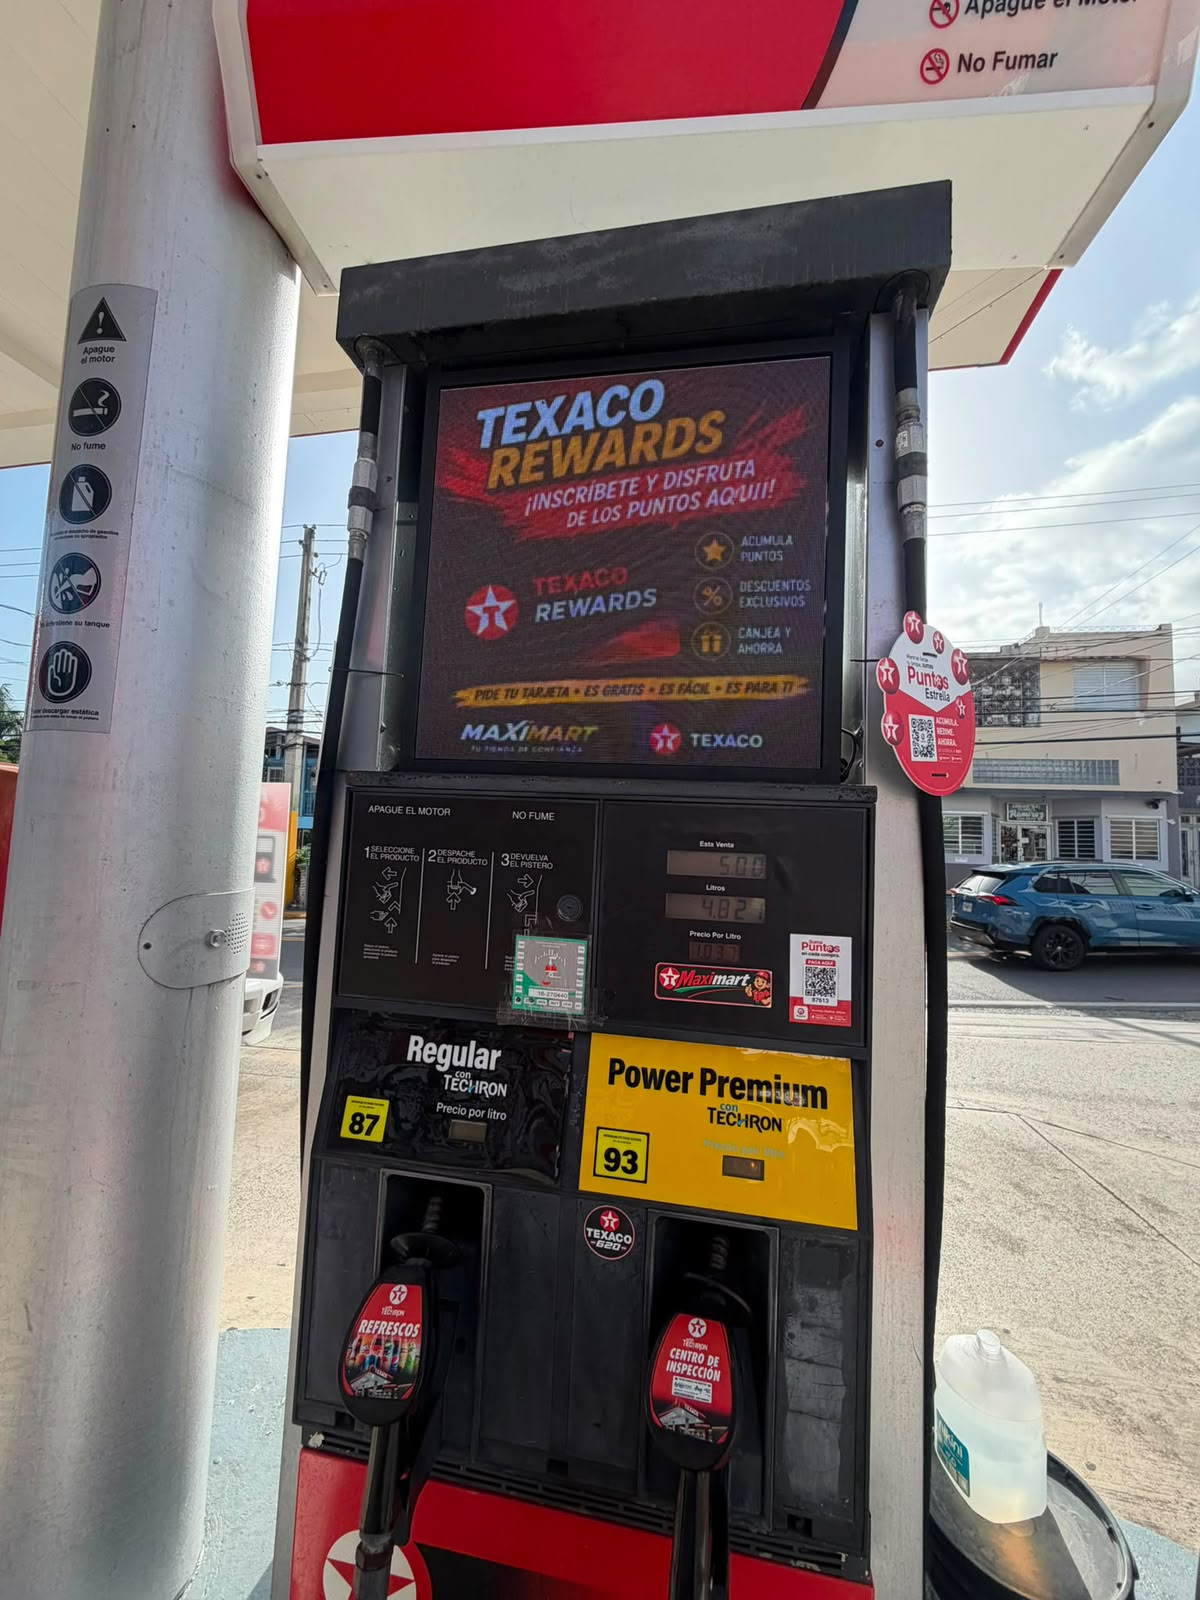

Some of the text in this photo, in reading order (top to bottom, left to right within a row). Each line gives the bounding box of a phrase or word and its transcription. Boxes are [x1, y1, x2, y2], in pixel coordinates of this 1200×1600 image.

[964, 0, 1044, 20] Apague
[957, 50, 1059, 73] No Fumar
[82, 345, 116, 356] Apague
[80, 355, 116, 365] el motor
[476, 379, 666, 450] TEXACO
[71, 441, 107, 452] No fume
[486, 410, 726, 490] REWARDS
[646, 473, 658, 492] Y
[663, 458, 757, 491] DISFRUTA
[567, 510, 587, 529] DE
[591, 506, 621, 526] LOS
[627, 491, 701, 519] PUNTOS
[740, 535, 794, 547] ACUMULA
[740, 550, 784, 563] PUNTOS
[532, 566, 629, 597] TEXACO
[739, 578, 812, 593] DESCUENTOS
[534, 588, 658, 624] REWARDS
[739, 594, 806, 609] EXCLUSIVOS
[84, 620, 111, 629] tanque
[738, 626, 792, 640] CANJEA Y
[738, 642, 784, 655] AHORRA
[907, 665, 950, 691] Puntos
[474, 680, 795, 701] PIDE TU TARJETA ES GRATIS ES FÁCIL ES PARA TI
[925, 687, 951, 702] Estrella
[690, 732, 763, 749] TEXACO
[368, 805, 451, 817] APAGUE EL MOTOR
[512, 811, 555, 821] NO FUME
[364, 846, 416, 858] 1 SELECCIONE
[699, 841, 735, 849] Esta Venta
[380, 854, 420, 862] PRODUCTO
[427, 849, 476, 863] 2 DESPACHE
[447, 857, 488, 866] PRODUCTO
[500, 853, 549, 867] 3 DEVUELVA
[520, 861, 554, 870] PISTERO
[706, 884, 726, 893] Litros
[689, 930, 742, 941] Precio Por Litro
[801, 941, 841, 954] Puntos
[675, 969, 751, 989] Maximart
[407, 1034, 502, 1072] Regular
[455, 1071, 472, 1079] con
[444, 1074, 508, 1098] TECHRON
[607, 1057, 829, 1110] Power Premium
[436, 1102, 507, 1121] Precio por litro
[719, 1102, 739, 1113] con
[349, 1112, 381, 1136] 87
[707, 1107, 783, 1134] TECHRON
[603, 1147, 639, 1175] 93
[585, 1227, 632, 1244] TEXACO
[595, 1239, 621, 1251] 620
[358, 1319, 421, 1338] REFRESCOS
[669, 1347, 720, 1367] CENTRO DE
[666, 1360, 721, 1382] INSPECCIÓN
